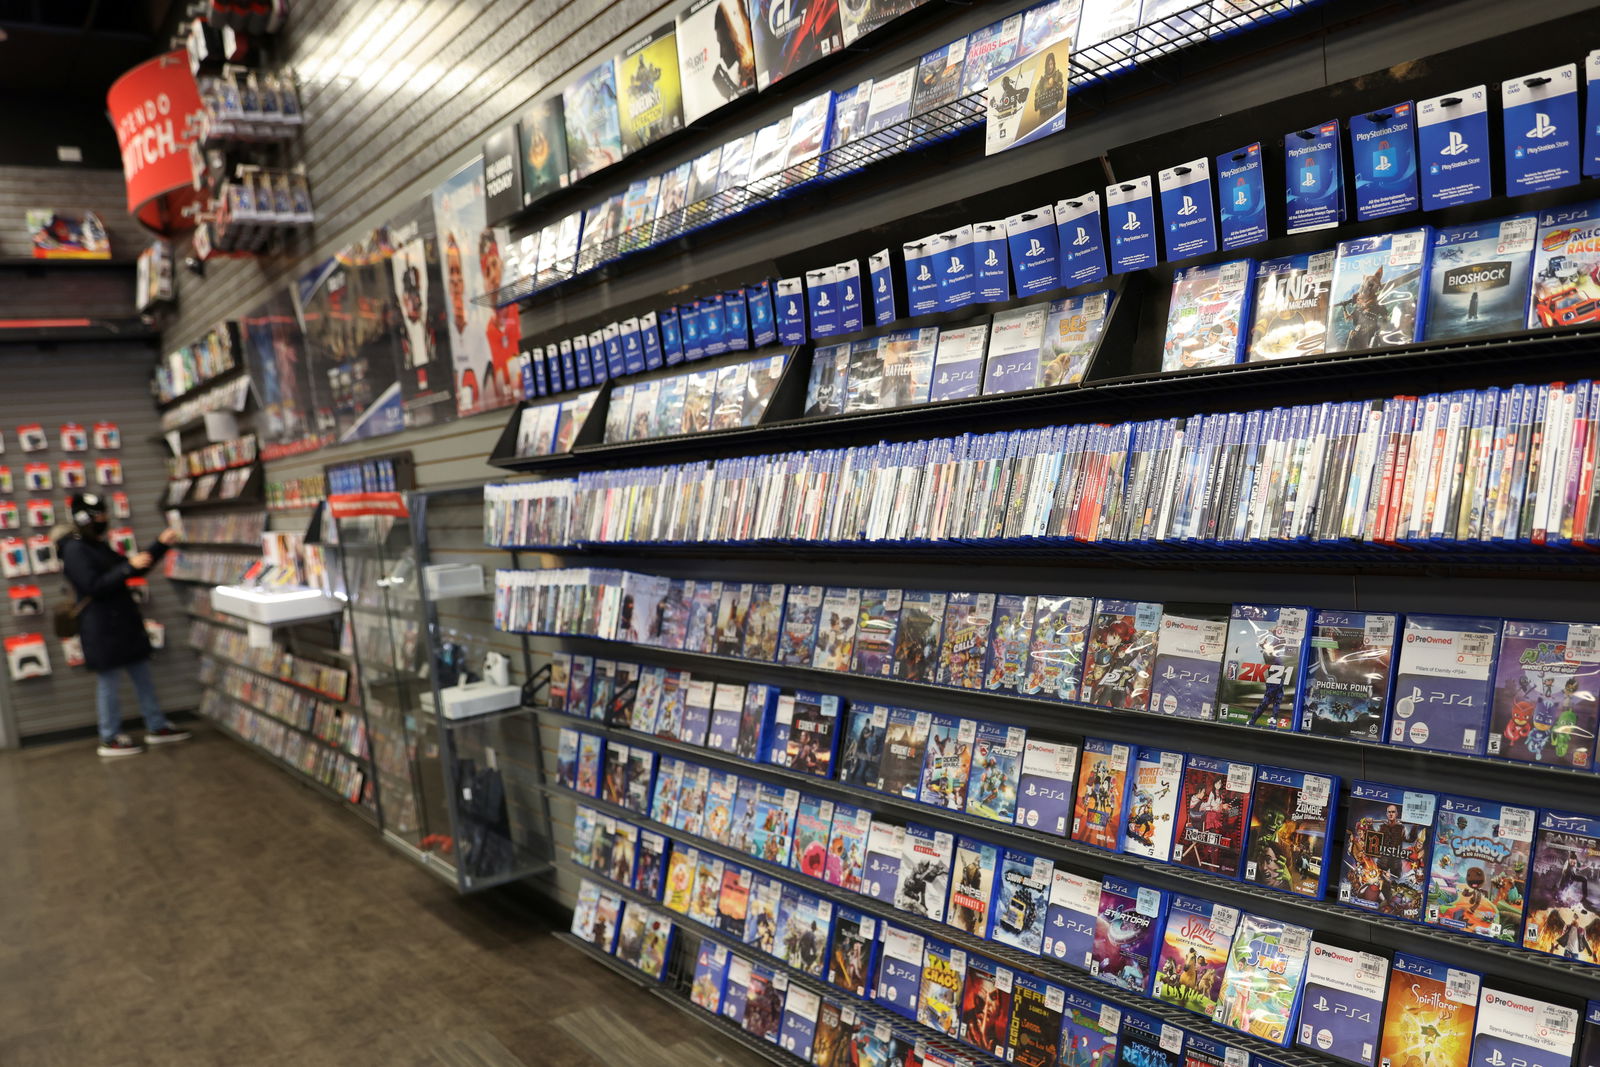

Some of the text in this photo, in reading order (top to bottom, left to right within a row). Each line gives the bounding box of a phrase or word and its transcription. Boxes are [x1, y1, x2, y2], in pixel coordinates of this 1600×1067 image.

[801, 9, 808, 24] 7
[1561, 70, 1572, 78] $10
[1472, 91, 1482, 100] $10
[118, 93, 170, 144] TENDO
[1356, 123, 1408, 141] PlayStation Store
[1288, 142, 1332, 157] PlayStation Store
[1527, 140, 1569, 155] PlayStation Store
[1221, 161, 1259, 178] PlayStation Store
[1441, 161, 1467, 171] PlayStation
[487, 172, 513, 199] TODAY
[1558, 210, 1589, 222] PS4
[1451, 231, 1479, 242] PS4
[1351, 243, 1376, 253] PS4
[1269, 263, 1292, 272] PS4
[1448, 268, 1505, 286] BIOSHOCK
[999, 324, 1021, 334] PreOwned
[1006, 361, 1032, 375] PS4
[951, 370, 974, 381] PS4
[1576, 394, 1584, 414] PS4
[1511, 401, 1519, 420] PS4
[1253, 461, 1262, 484] JUST
[1202, 464, 1215, 509] JUMP FORCE
[1248, 485, 1259, 511] CAUSE
[1326, 616, 1349, 624] PS4
[1172, 621, 1198, 631] PreOwned
[1519, 627, 1548, 636] PS4
[1415, 635, 1452, 645] PreOwned
[1522, 664, 1541, 672] HEROES
[1179, 670, 1209, 684] PS4
[1238, 662, 1294, 686] 2K21
[1316, 681, 1372, 692] PHOENIX POINT
[1429, 692, 1473, 707] PS4
[985, 727, 1000, 735] PS4
[1091, 744, 1104, 752] PS4
[943, 755, 960, 763] RIDERS
[1198, 761, 1218, 769] PS4
[1271, 774, 1292, 783] PS4
[1039, 787, 1065, 800] PS4
[1365, 788, 1389, 799] PS4
[1296, 804, 1322, 816] ZOMBIE
[1456, 802, 1481, 814] PS4
[1557, 821, 1587, 832] PS4
[913, 828, 928, 837] PS4
[1368, 831, 1412, 860] Rustler
[1545, 832, 1597, 848] SAINTS
[1452, 837, 1510, 860] SACKBOY
[1011, 855, 1026, 864] PS4
[1061, 876, 1083, 887] PreOwned
[955, 883, 986, 899] SNIPER
[1111, 884, 1128, 894] PS4
[1182, 901, 1202, 912] PS4
[1217, 911, 1232, 919] $19.99
[1067, 920, 1093, 936] PS4
[1528, 929, 1537, 937] M
[1198, 943, 1216, 952] ADVENTURE
[1322, 950, 1353, 963] PreOwned
[1408, 964, 1433, 975] PS4
[896, 969, 916, 982] PS4
[925, 968, 958, 990] CHAOS
[1022, 980, 1037, 989] PS4
[1075, 998, 1091, 1007] PS4
[1412, 984, 1458, 1011] Spiritfarer
[1495, 997, 1534, 1012] PreOwned
[1334, 1003, 1370, 1023] PS4
[1546, 1006, 1573, 1016] PRE-OWNED
[1133, 1019, 1150, 1030] PS4
[1489, 1025, 1502, 1034] Spyro
[1525, 1033, 1541, 1043] Trilogy
[1541, 1037, 1556, 1047] <PS4>
[1131, 1041, 1167, 1060] THOSE WHO
[1196, 1042, 1214, 1052] PS4
